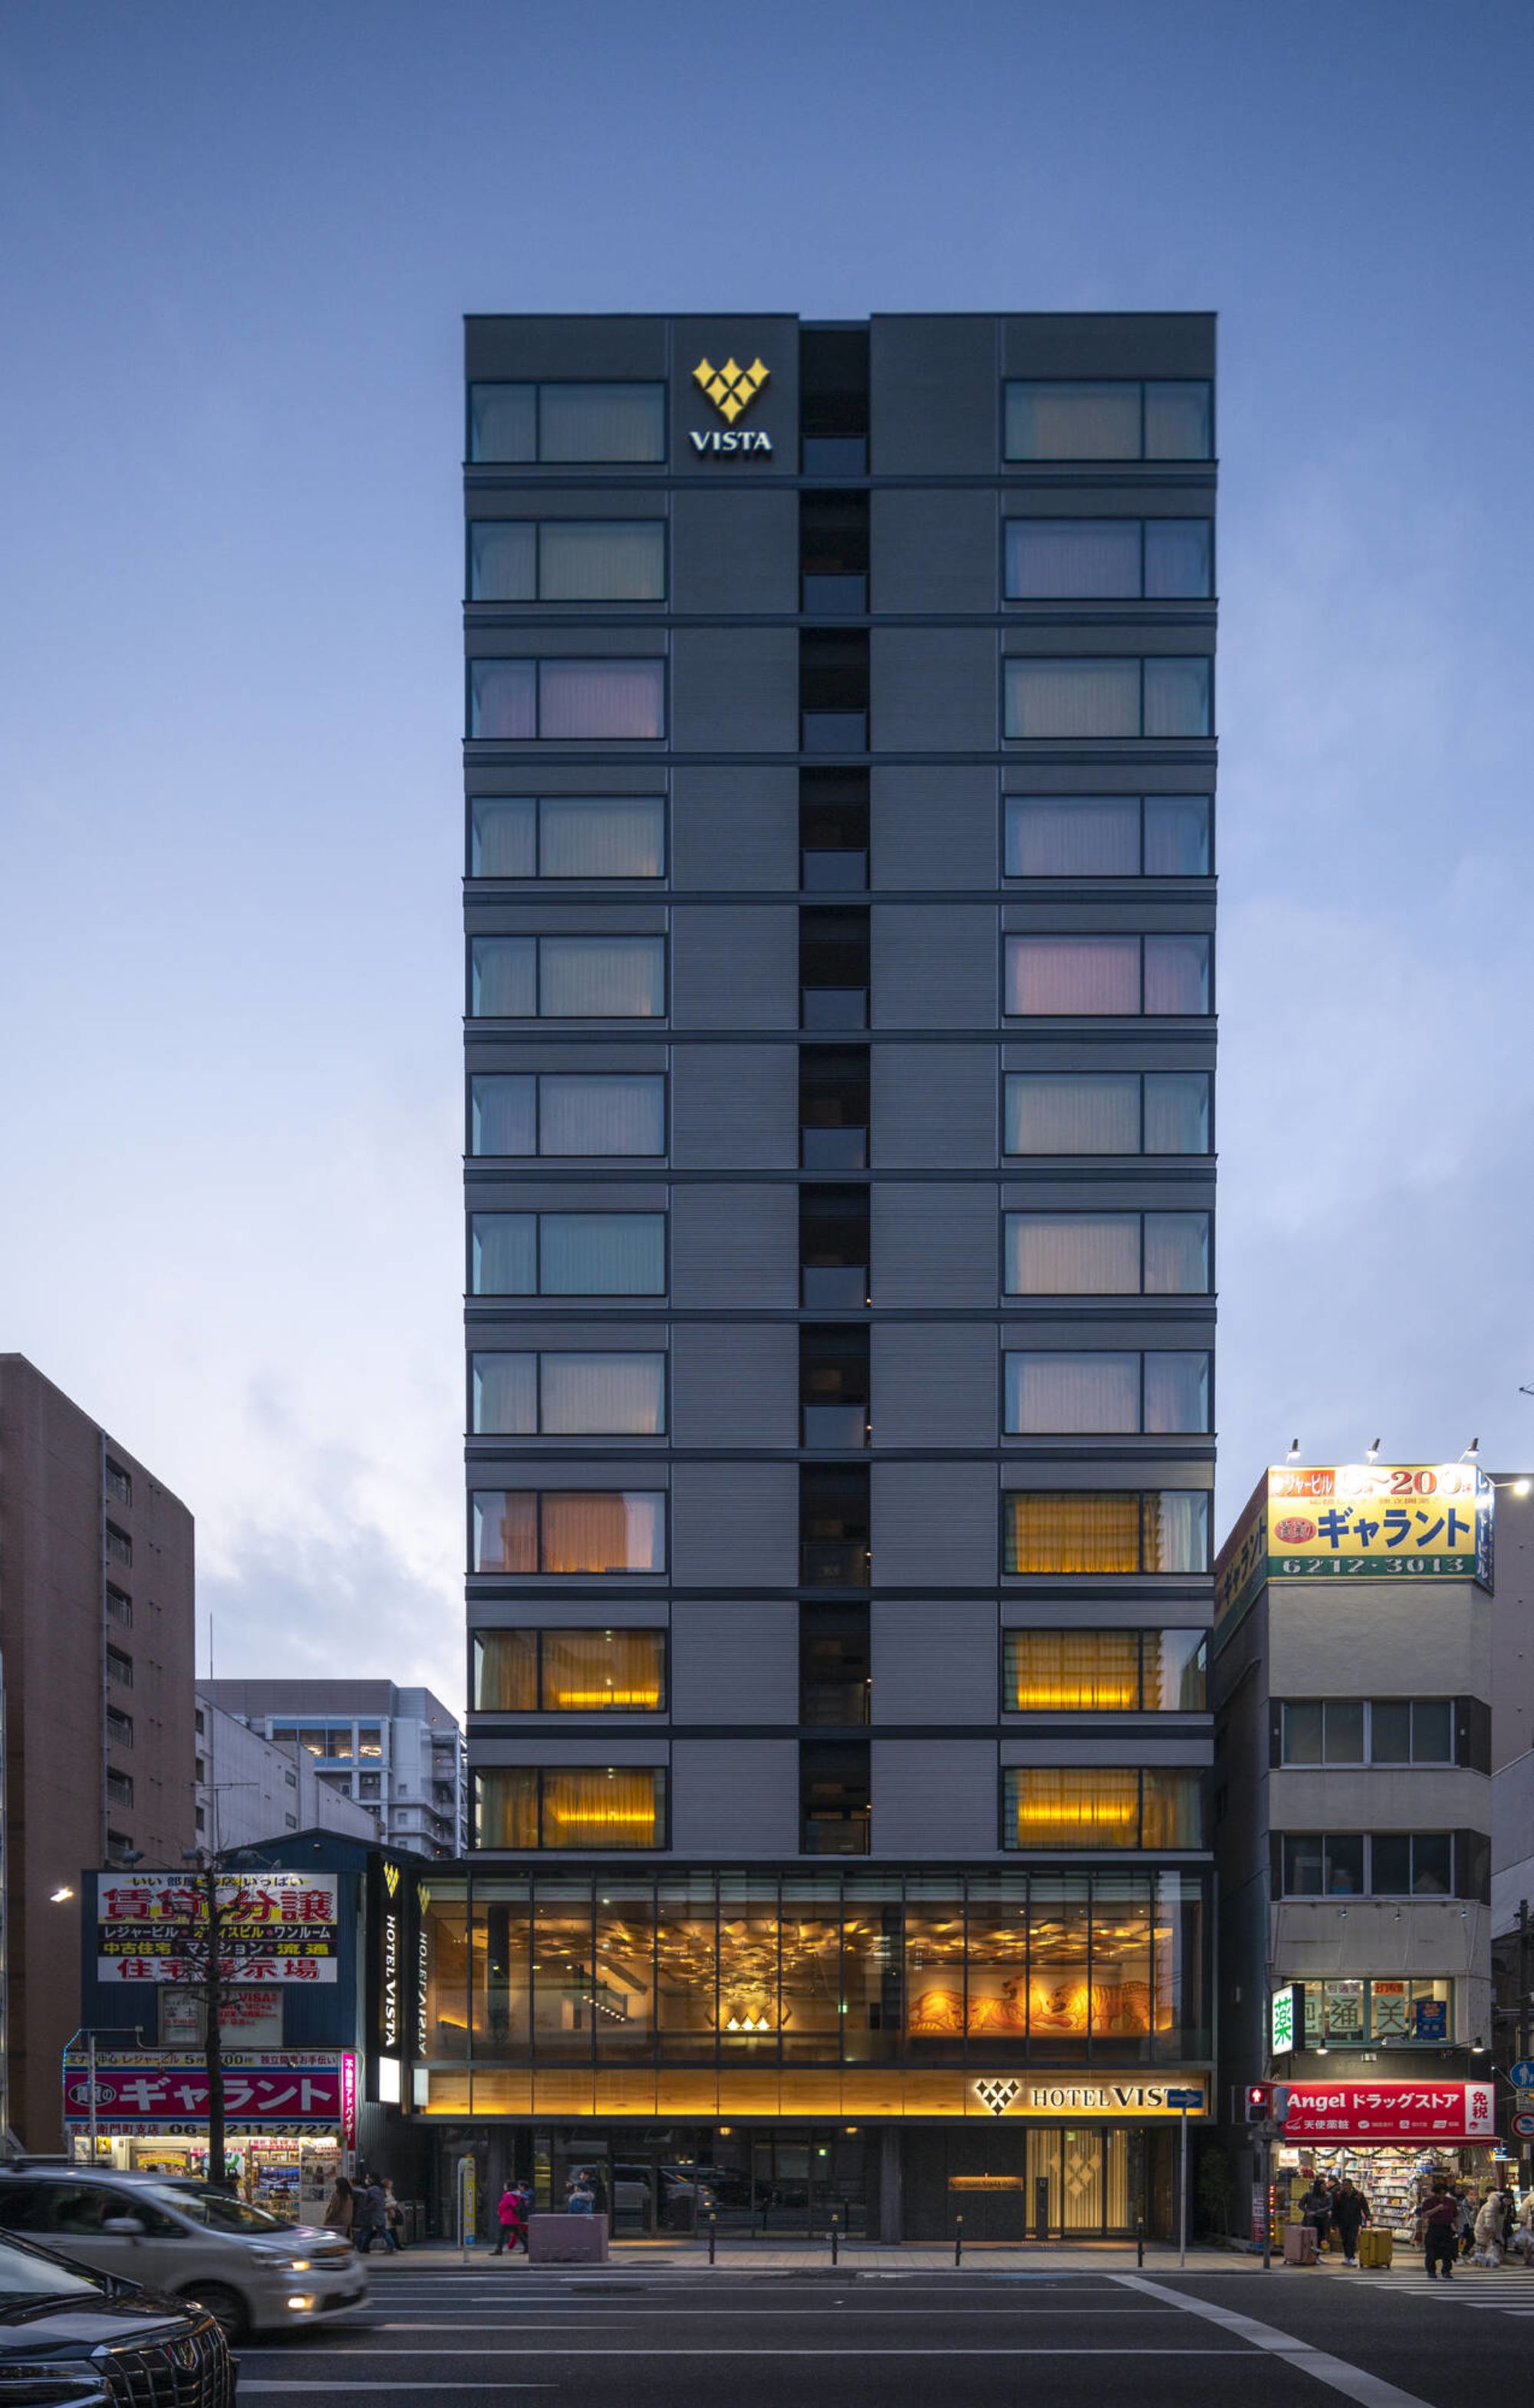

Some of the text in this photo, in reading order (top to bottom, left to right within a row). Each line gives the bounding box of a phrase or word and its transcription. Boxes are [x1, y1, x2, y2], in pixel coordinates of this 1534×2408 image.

[690, 432, 772, 450] VISTA
[1318, 1506, 1470, 1548] ギャラント
[386, 1914, 396, 2048] HOTEL VISTA
[1274, 1996, 1292, 2046] 薬
[119, 2077, 332, 2111] ギャラント
[1032, 2087, 1191, 2107] HOTEL VIS
[1287, 2093, 1460, 2112] Angel ドラッグストア
[1472, 2091, 1489, 2119] 免税
[169, 2123, 332, 2136] 06-211-2727
